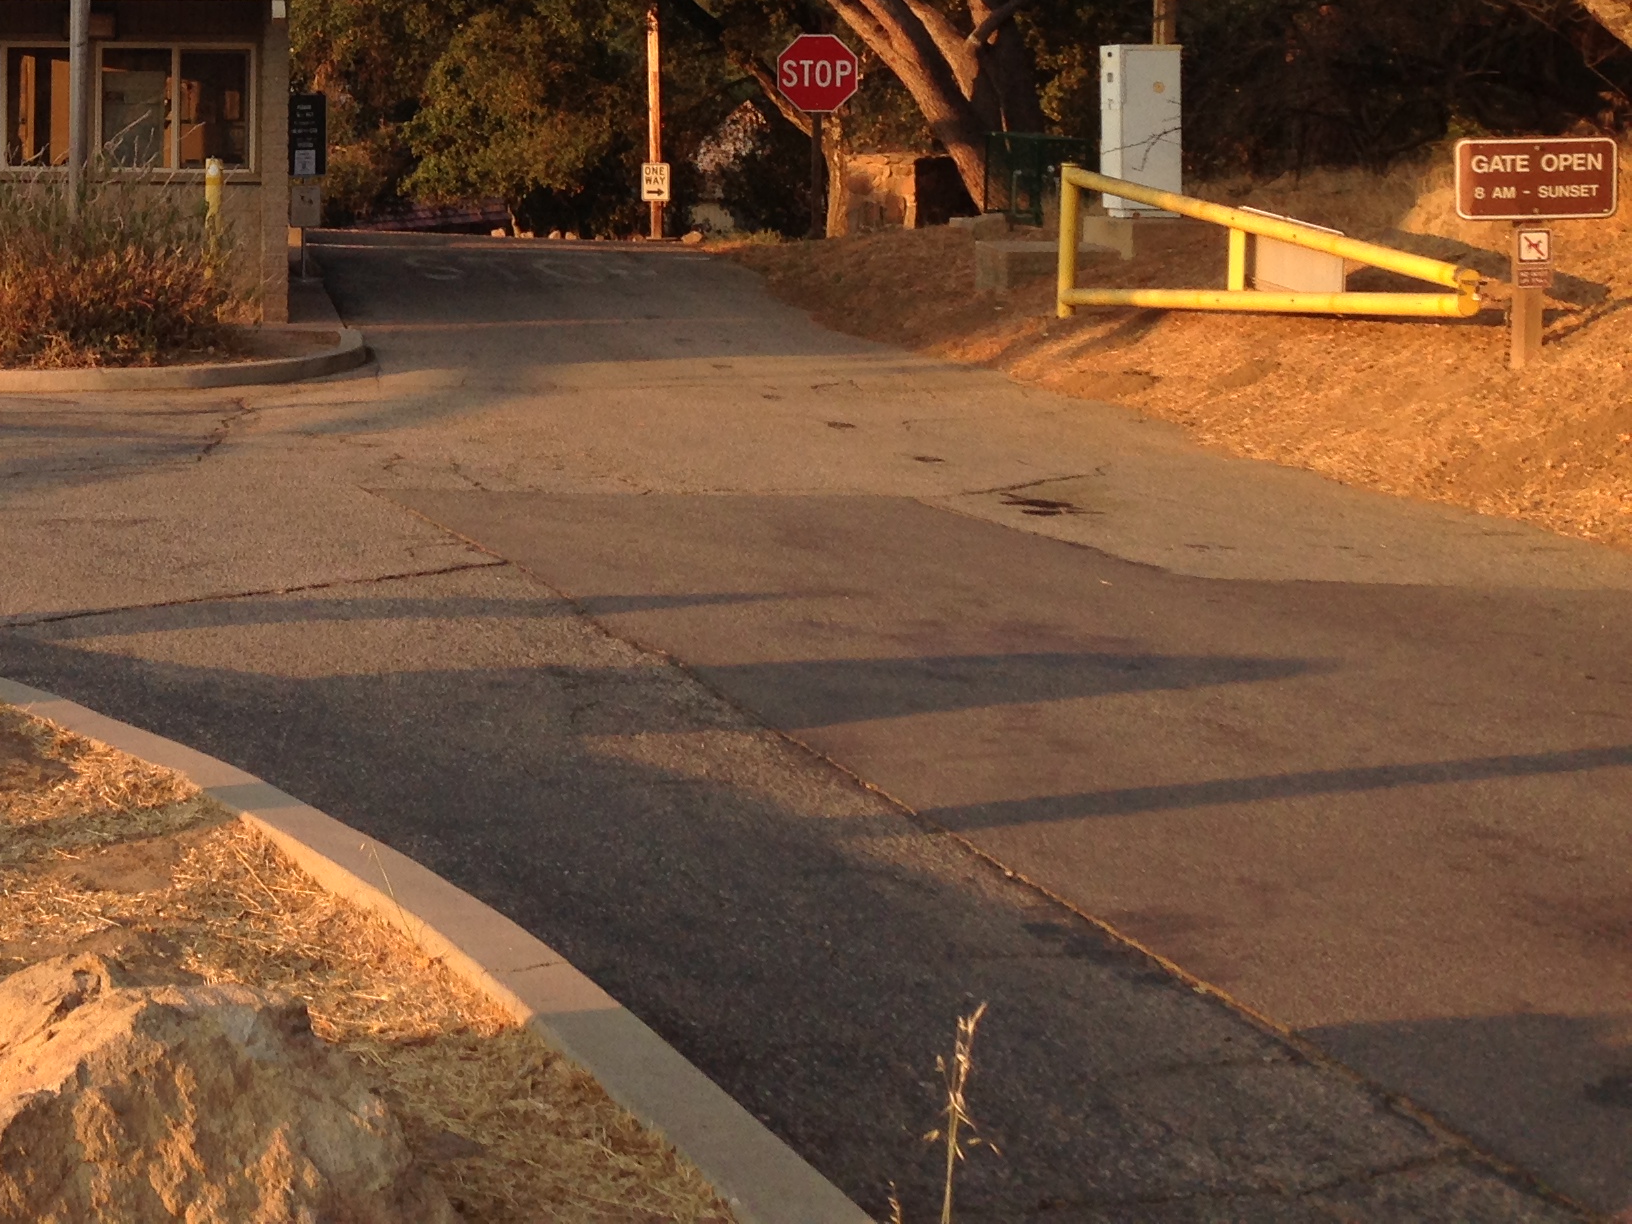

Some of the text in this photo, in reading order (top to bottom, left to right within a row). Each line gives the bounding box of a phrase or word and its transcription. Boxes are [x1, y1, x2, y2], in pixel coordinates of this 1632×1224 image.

[781, 59, 852, 88] STOP
[644, 166, 665, 175] ONE
[1471, 153, 1603, 173] GATE OPEN
[645, 176, 666, 185] WAY
[1474, 187, 1485, 199] 8
[1492, 186, 1517, 199] AM
[1538, 184, 1599, 198] SUNSET
